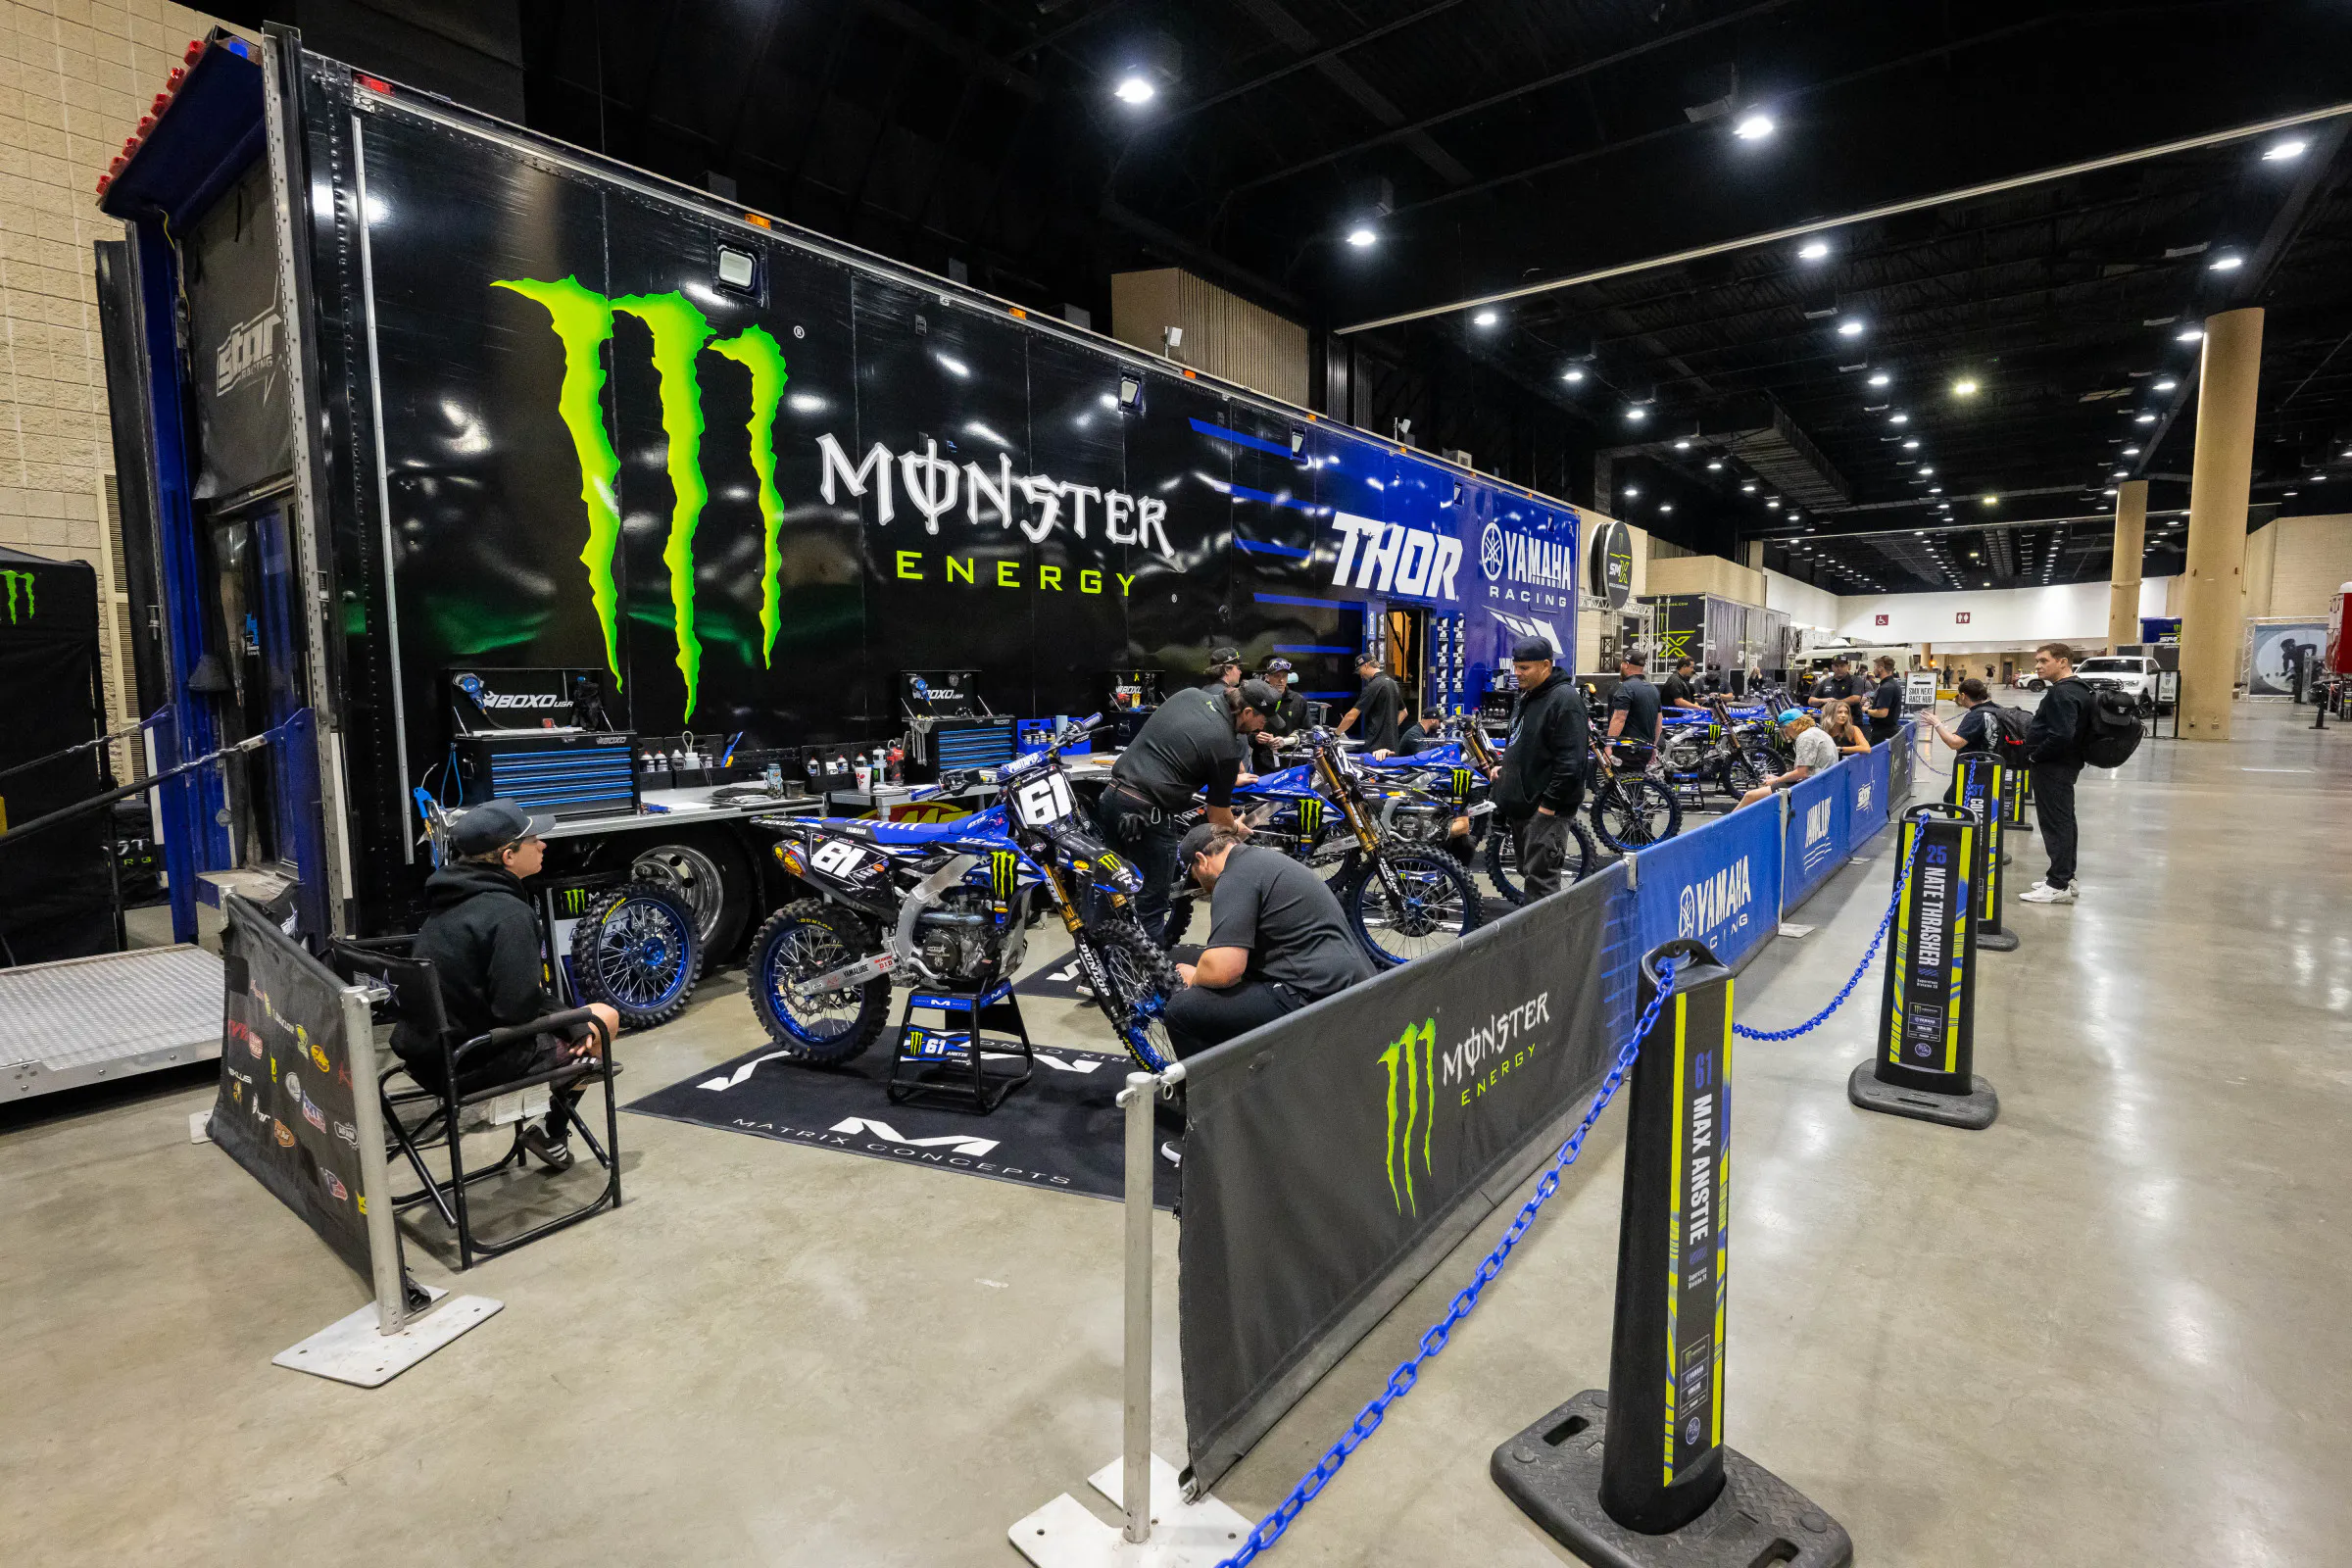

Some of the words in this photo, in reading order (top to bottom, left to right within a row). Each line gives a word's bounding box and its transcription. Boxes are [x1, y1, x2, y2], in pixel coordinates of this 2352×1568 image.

[815, 432, 1175, 560] MONSTER
[896, 550, 1136, 597] ENERGY
[1331, 511, 1463, 601] THOR
[1504, 530, 1571, 591] YAMAHA
[1489, 585, 1567, 608] RACING
[496, 694, 557, 708] BOXO
[1019, 772, 1072, 824] 61
[1926, 845, 1947, 863] 25
[1696, 855, 1751, 937] YAMAHA
[1923, 866, 1946, 899] NATE
[602, 898, 626, 924] DUNLOP
[800, 918, 834, 931] DUNLOP
[1709, 912, 1748, 950] CING
[1918, 899, 1944, 967] THRASHER
[843, 964, 869, 977] YAMALUBE
[1079, 943, 1110, 997] DUNLOP
[924, 1038, 947, 1054] 61
[1442, 992, 1550, 1086] MONSTER
[1460, 1043, 1536, 1106] ENERGY
[1694, 1050, 1713, 1090] 61
[1692, 1093, 1713, 1154] MAX
[733, 1118, 849, 1147] MATRIX
[866, 1143, 1071, 1185] CONCEPTS
[1690, 1155, 1711, 1246] ANSTIE
